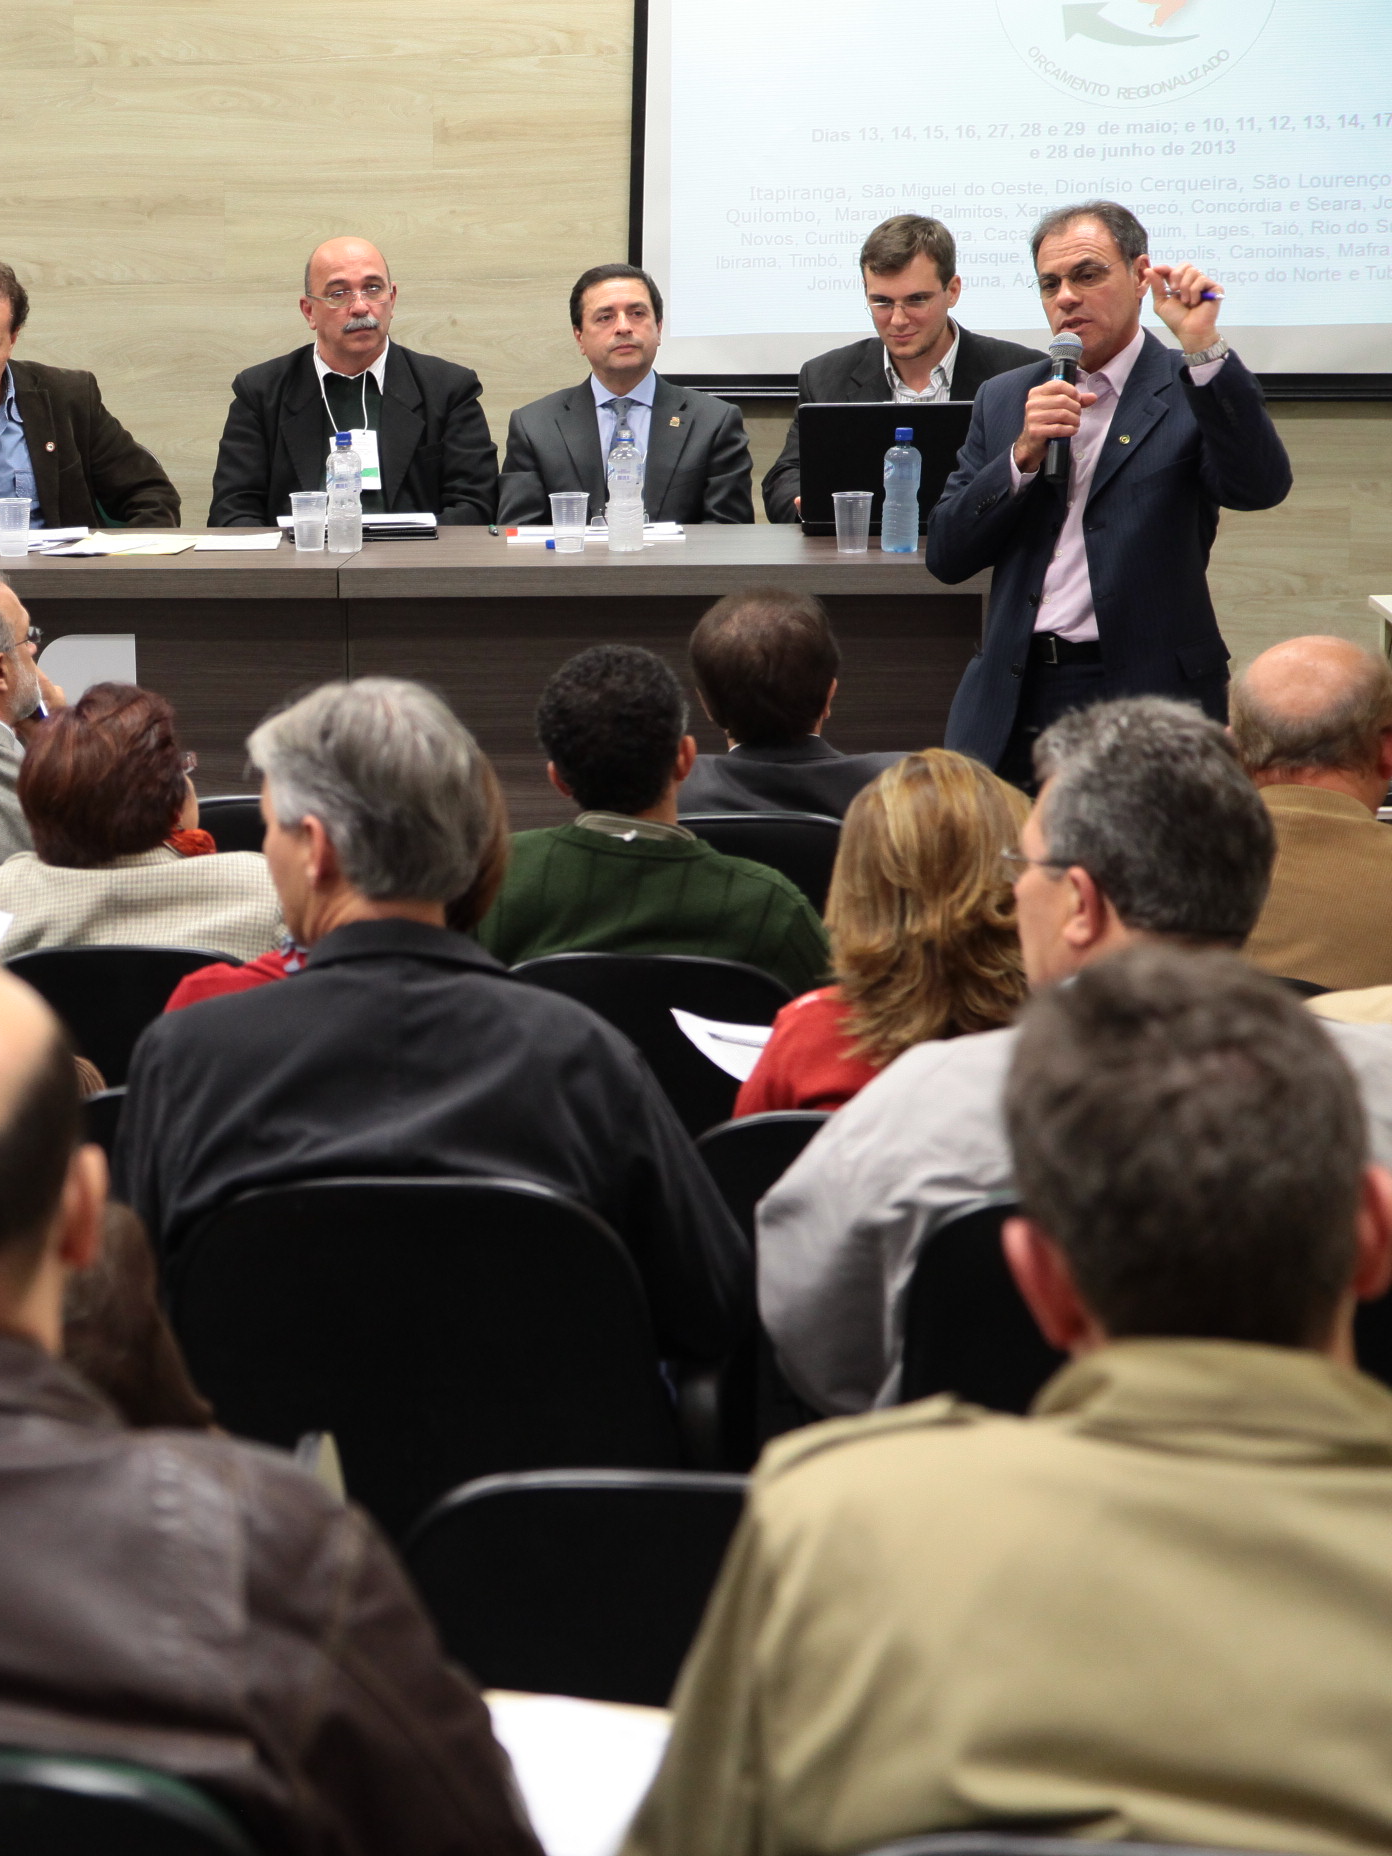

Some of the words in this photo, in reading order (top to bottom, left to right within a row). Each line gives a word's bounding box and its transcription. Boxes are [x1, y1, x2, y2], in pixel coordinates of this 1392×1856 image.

[1028, 46, 1110, 97] ORÇAMENTO
[1117, 49, 1230, 100] REGIONALIZADO
[811, 128, 851, 143] Dias
[859, 127, 884, 142] 13,
[891, 126, 917, 141] 14,
[923, 125, 949, 141] 15,
[956, 124, 981, 140] 16,
[987, 123, 1014, 140] 27,
[1020, 122, 1042, 137] 28
[1048, 125, 1058, 136] e
[1063, 121, 1086, 136] 29
[1097, 121, 1120, 135] de
[1126, 119, 1178, 135] maio;
[1184, 121, 1195, 132] e
[1203, 117, 1230, 134] 10,
[1236, 116, 1262, 133] 11,
[1268, 116, 1295, 132] 12,
[1303, 114, 1331, 131] 13,
[1337, 114, 1365, 130] 14,
[1029, 148, 1040, 159] e
[1046, 144, 1068, 159] 28
[1073, 144, 1096, 158] de
[1101, 143, 1155, 161] junho
[1162, 142, 1185, 156] de
[1190, 140, 1236, 155] 2013
[749, 186, 852, 203] Itapiranga,
[861, 183, 895, 199] São
[901, 183, 956, 200] Miguel
[964, 182, 985, 196] do
[991, 181, 1048, 196] Oeste,
[1055, 177, 1133, 194] Dionísio
[1140, 176, 1244, 194] Cerqueira,
[1252, 174, 1290, 190] São
[1298, 173, 1392, 190] Lourenço
[726, 206, 821, 227] Quilombo,
[930, 204, 1008, 219] Palmitos,
[1191, 197, 1282, 214] Concórdia
[1289, 200, 1300, 211] e
[1307, 196, 1366, 212] Seara,
[741, 232, 799, 247] Novos,
[805, 230, 868, 245] Curitiba
[1195, 223, 1254, 240] Lages,
[1261, 220, 1304, 238] Taió,
[1311, 220, 1341, 235] Rio
[1346, 219, 1369, 234] do
[716, 255, 782, 270] Ibirama,
[789, 253, 842, 268] Timbó,
[1229, 243, 1330, 260] Canoinhas,
[1265, 267, 1287, 282] do
[1293, 267, 1342, 282] Norte
[1349, 269, 1360, 280] e
